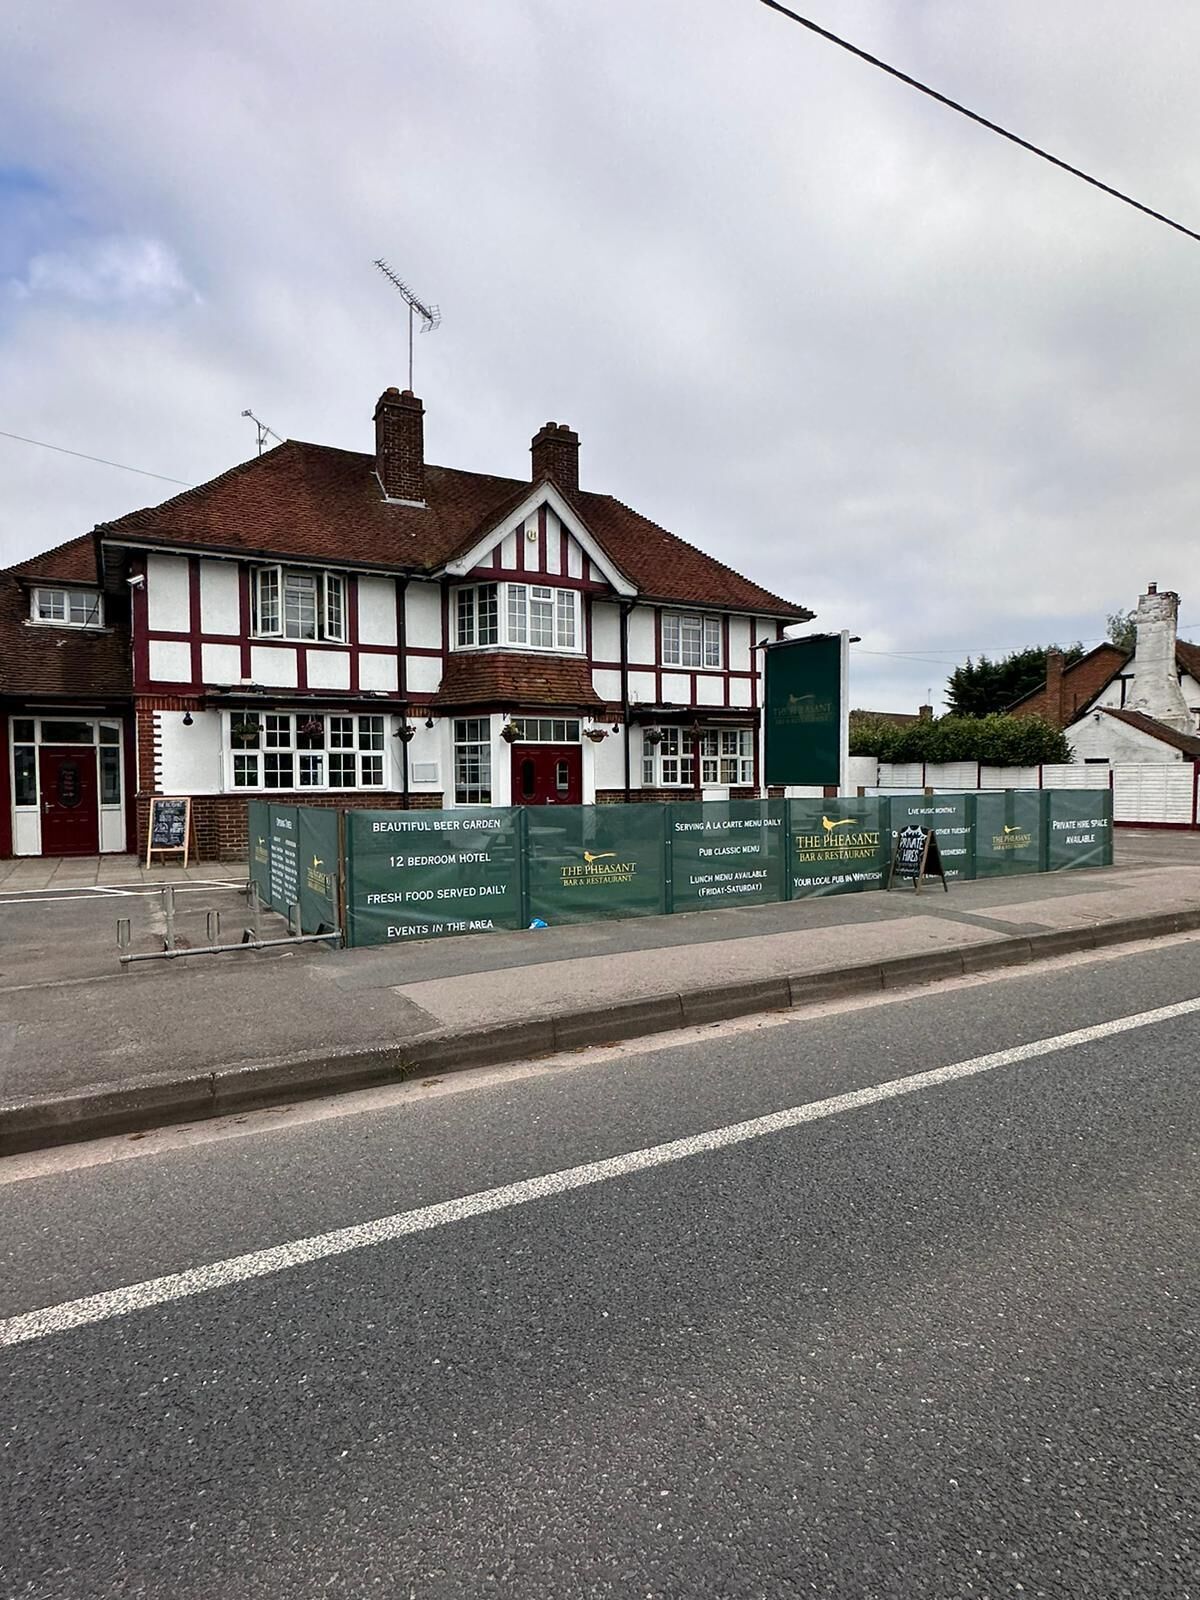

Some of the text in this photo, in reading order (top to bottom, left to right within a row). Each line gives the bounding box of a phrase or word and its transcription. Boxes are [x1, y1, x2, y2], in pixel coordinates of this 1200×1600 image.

[372, 819, 501, 832] BEAUTIFUL BEER GARDEN
[675, 818, 782, 832] SERVING A LA CARTE MENU DAILY
[1052, 818, 1108, 830] PRIVATE HIRE SPACE
[796, 836, 819, 848] THE
[823, 832, 880, 847] PHEASANT
[900, 837, 924, 850] PRIVATE
[1065, 834, 1095, 844] AVAILABLE
[699, 844, 760, 857] PUB CLASSIC MENU
[800, 849, 876, 862] BAR & RESTAURANT
[902, 849, 919, 862] HIRES
[390, 853, 491, 867] 12 BEDROOM HOTEL
[561, 863, 637, 877] THE PHEASANT
[563, 875, 633, 887] BAR & RESTAURANT
[690, 870, 767, 884] LUNCH MENU AVAILABLE
[793, 877, 812, 888] YOUR
[812, 876, 831, 886] LOCAL
[831, 875, 844, 884] PUB
[844, 875, 852, 883] IN
[367, 885, 506, 904] FRESH FOOD SERVED DAILY
[698, 882, 762, 898] (FRIDAY-SATURDAY)
[387, 920, 494, 937] EVENTS IN THE AREA
